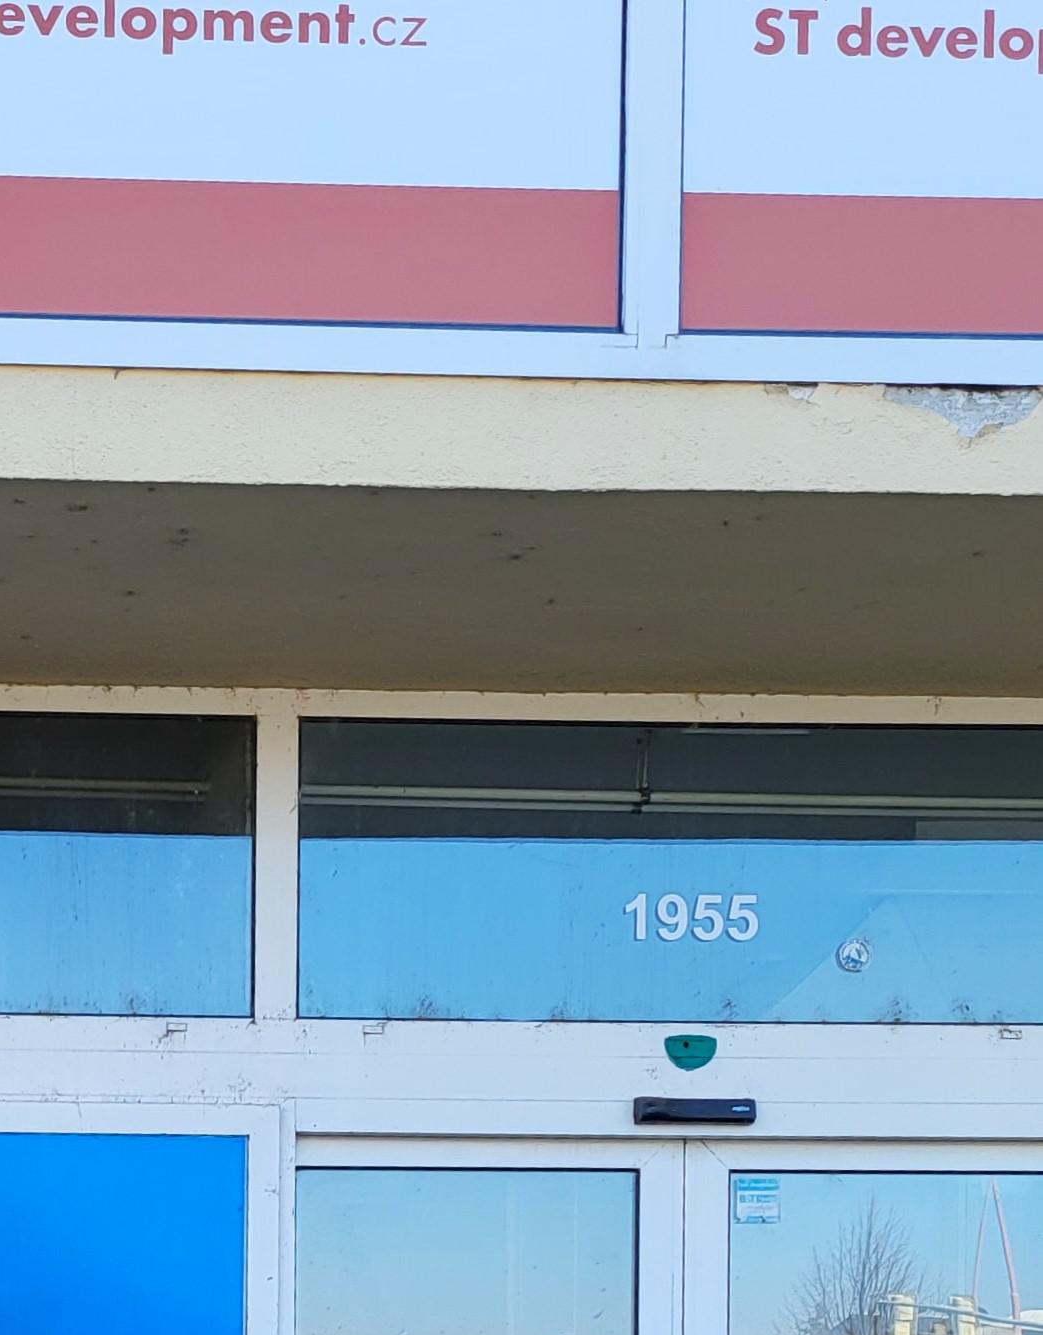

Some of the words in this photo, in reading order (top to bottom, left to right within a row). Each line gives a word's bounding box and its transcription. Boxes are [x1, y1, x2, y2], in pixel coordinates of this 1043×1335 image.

[754, 8, 818, 55] ST
[837, 7, 1043, 75] develo
[623, 893, 759, 942] 1955
